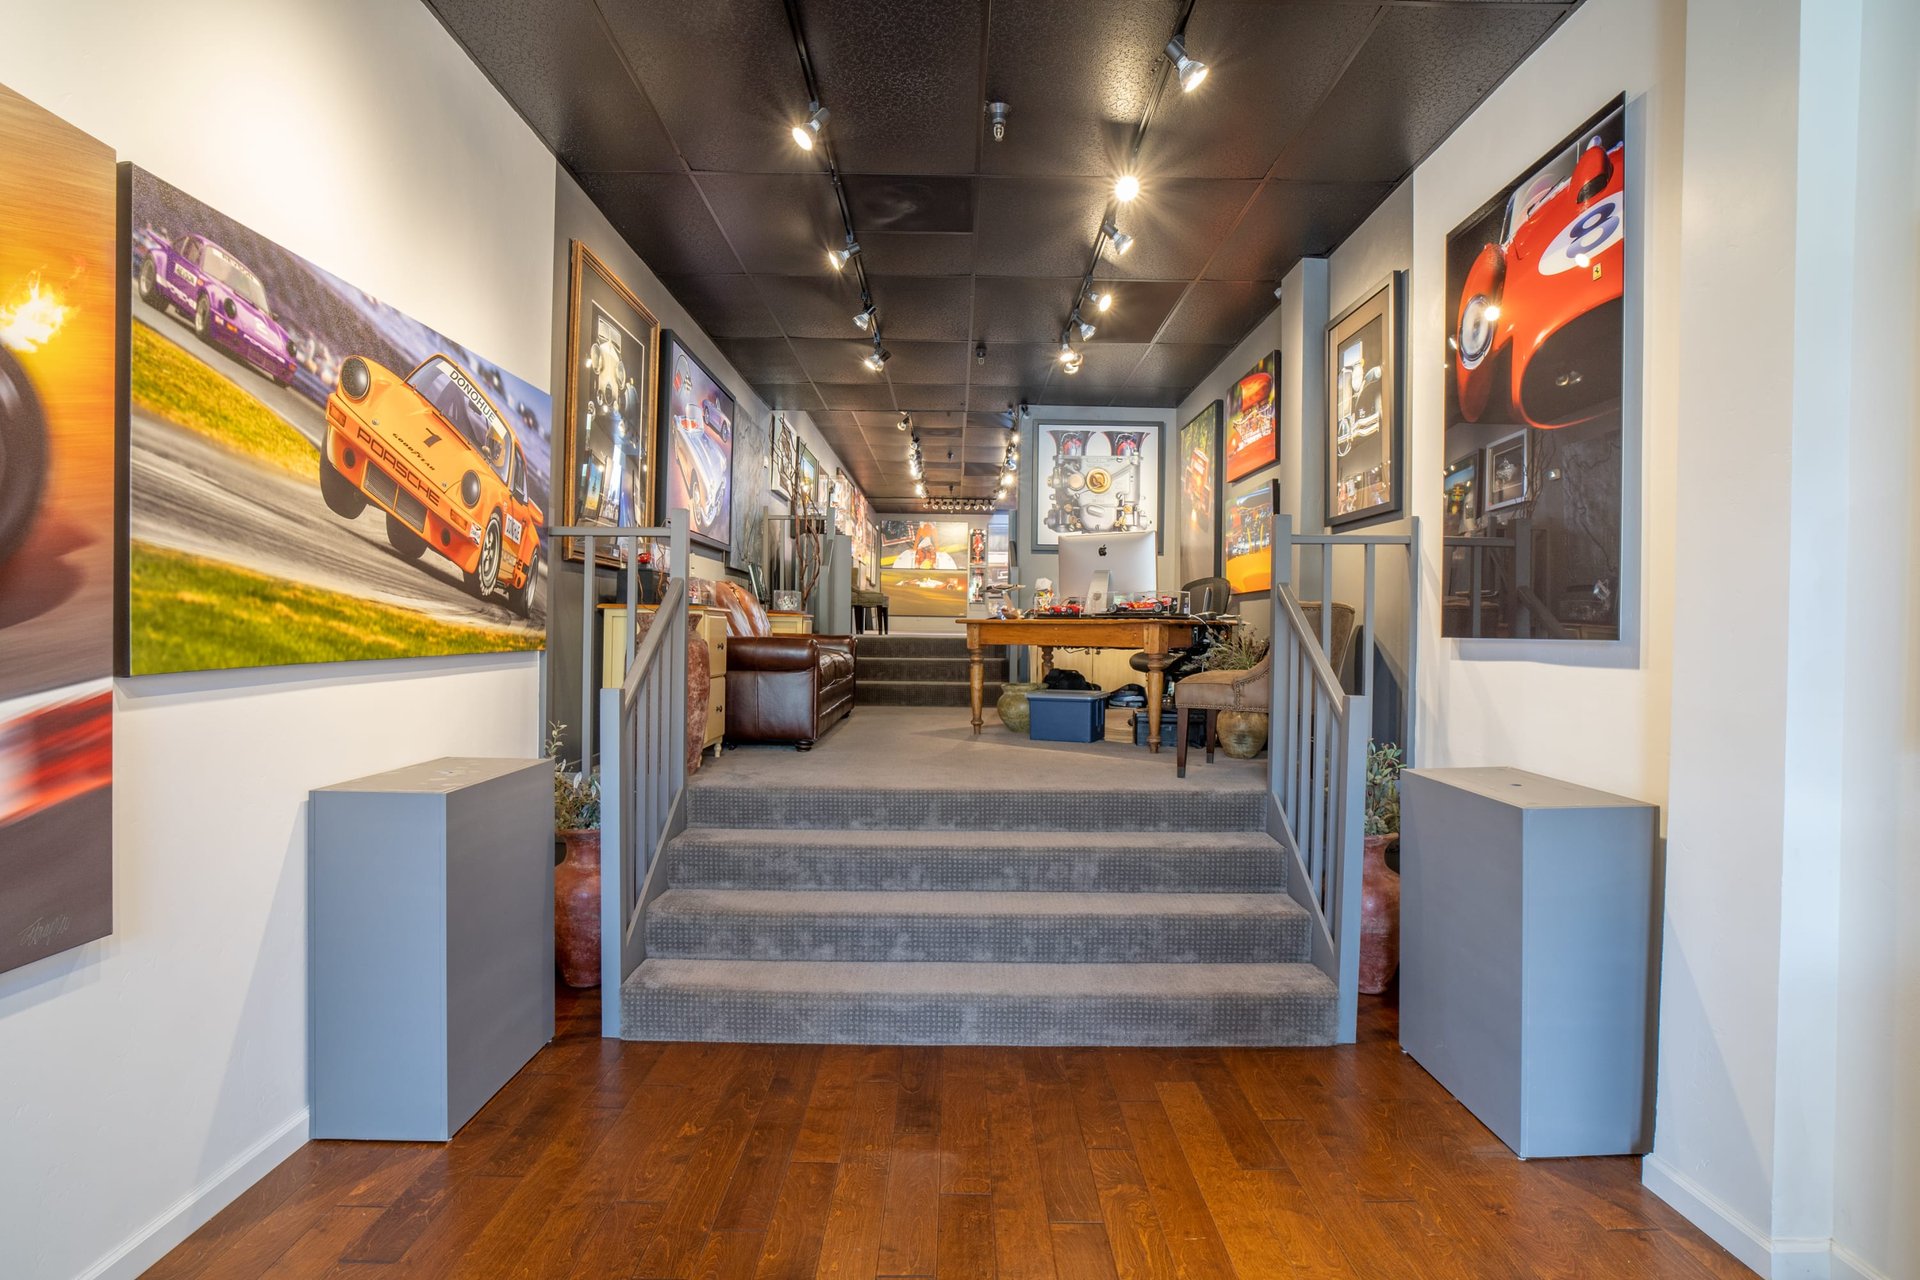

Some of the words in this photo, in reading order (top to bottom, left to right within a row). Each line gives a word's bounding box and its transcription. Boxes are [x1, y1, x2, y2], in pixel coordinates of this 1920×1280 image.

[1567, 203, 1620, 258] 8
[449, 370, 495, 423] DONOHUE
[424, 428, 442, 447] 7
[357, 426, 440, 507] PORSCHE
